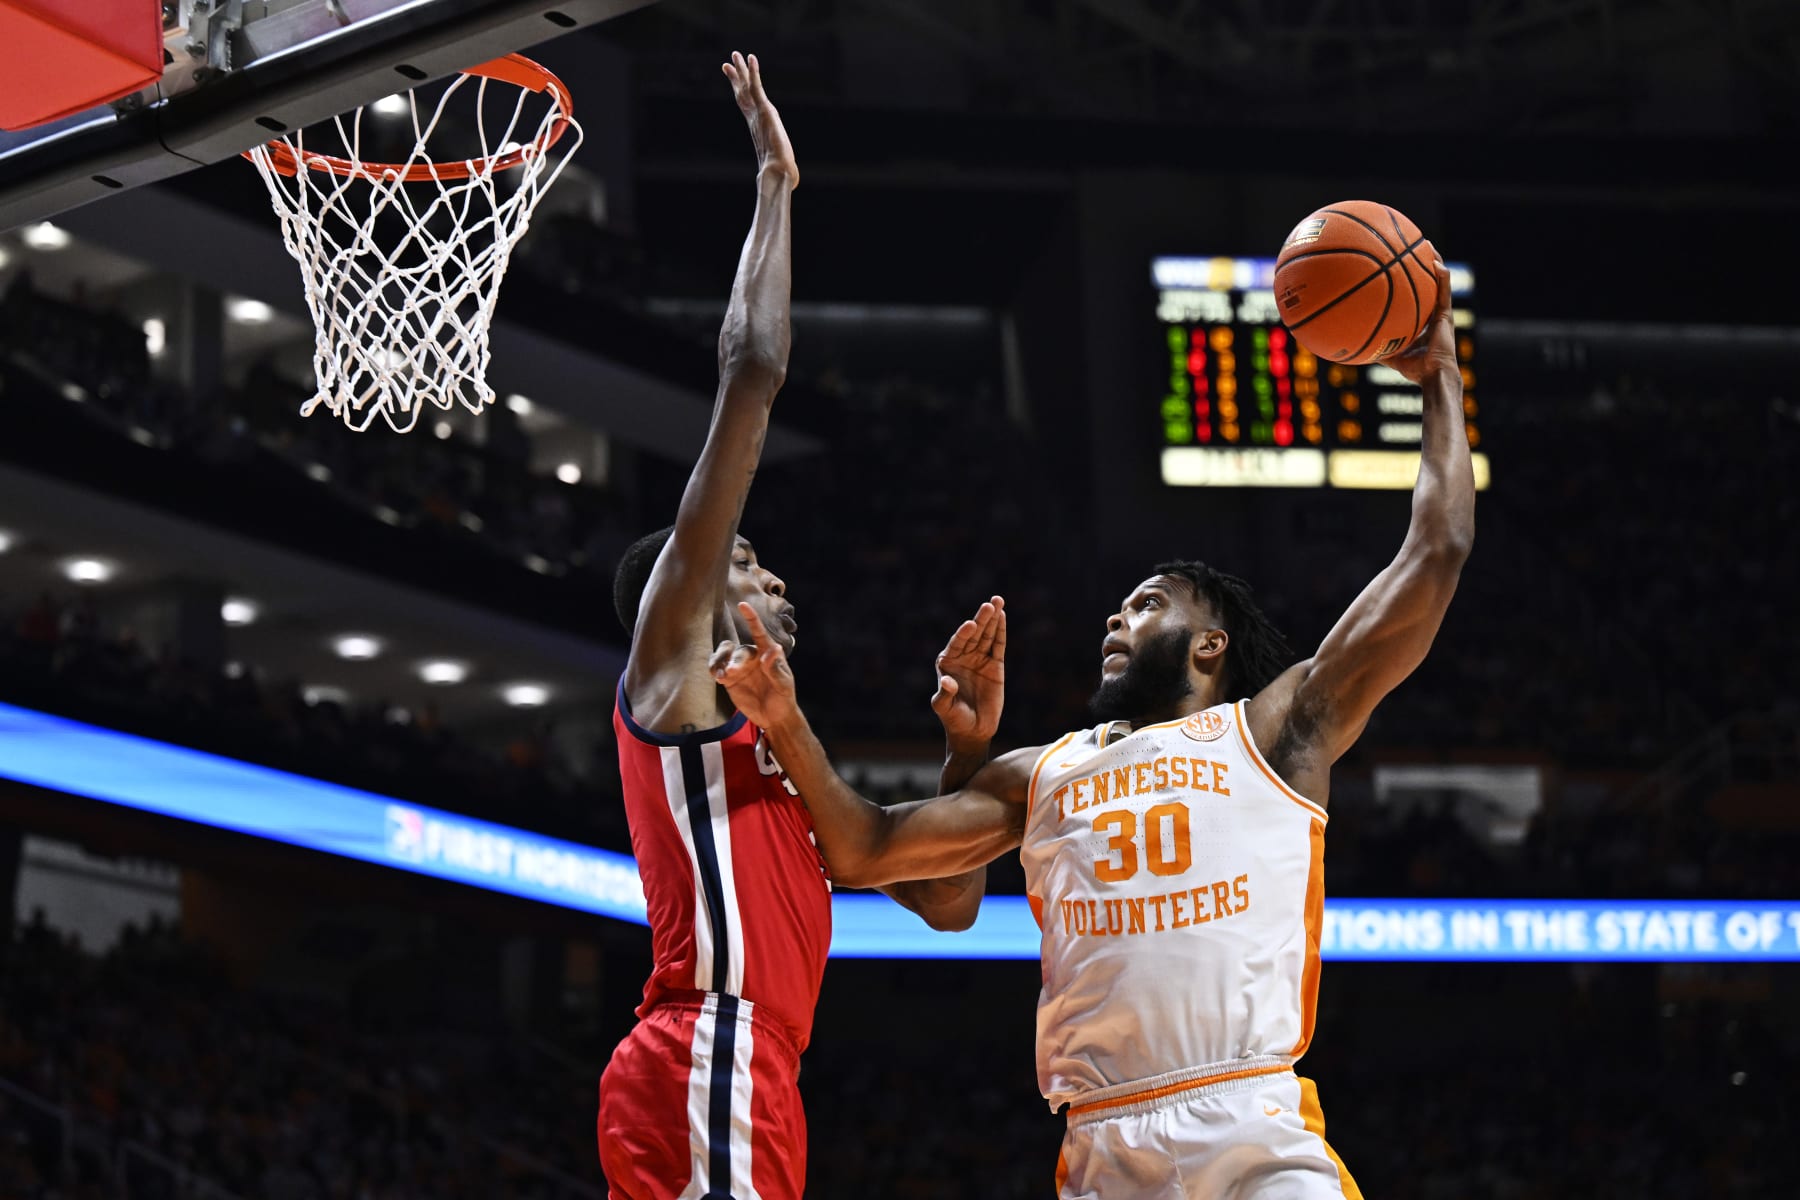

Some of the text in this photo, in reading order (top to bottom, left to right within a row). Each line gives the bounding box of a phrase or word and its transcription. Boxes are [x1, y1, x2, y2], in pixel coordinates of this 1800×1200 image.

[1186, 711, 1222, 733] SEC
[1053, 756, 1231, 824] TENNESSEE
[425, 820, 513, 878] FIRST
[1091, 801, 1193, 883] 30
[1060, 873, 1250, 937] VOLUNTEERS
[1451, 909, 1499, 951] IN
[1503, 909, 1589, 951] THE
[1595, 909, 1718, 951] STATE
[1724, 909, 1782, 951] OF
